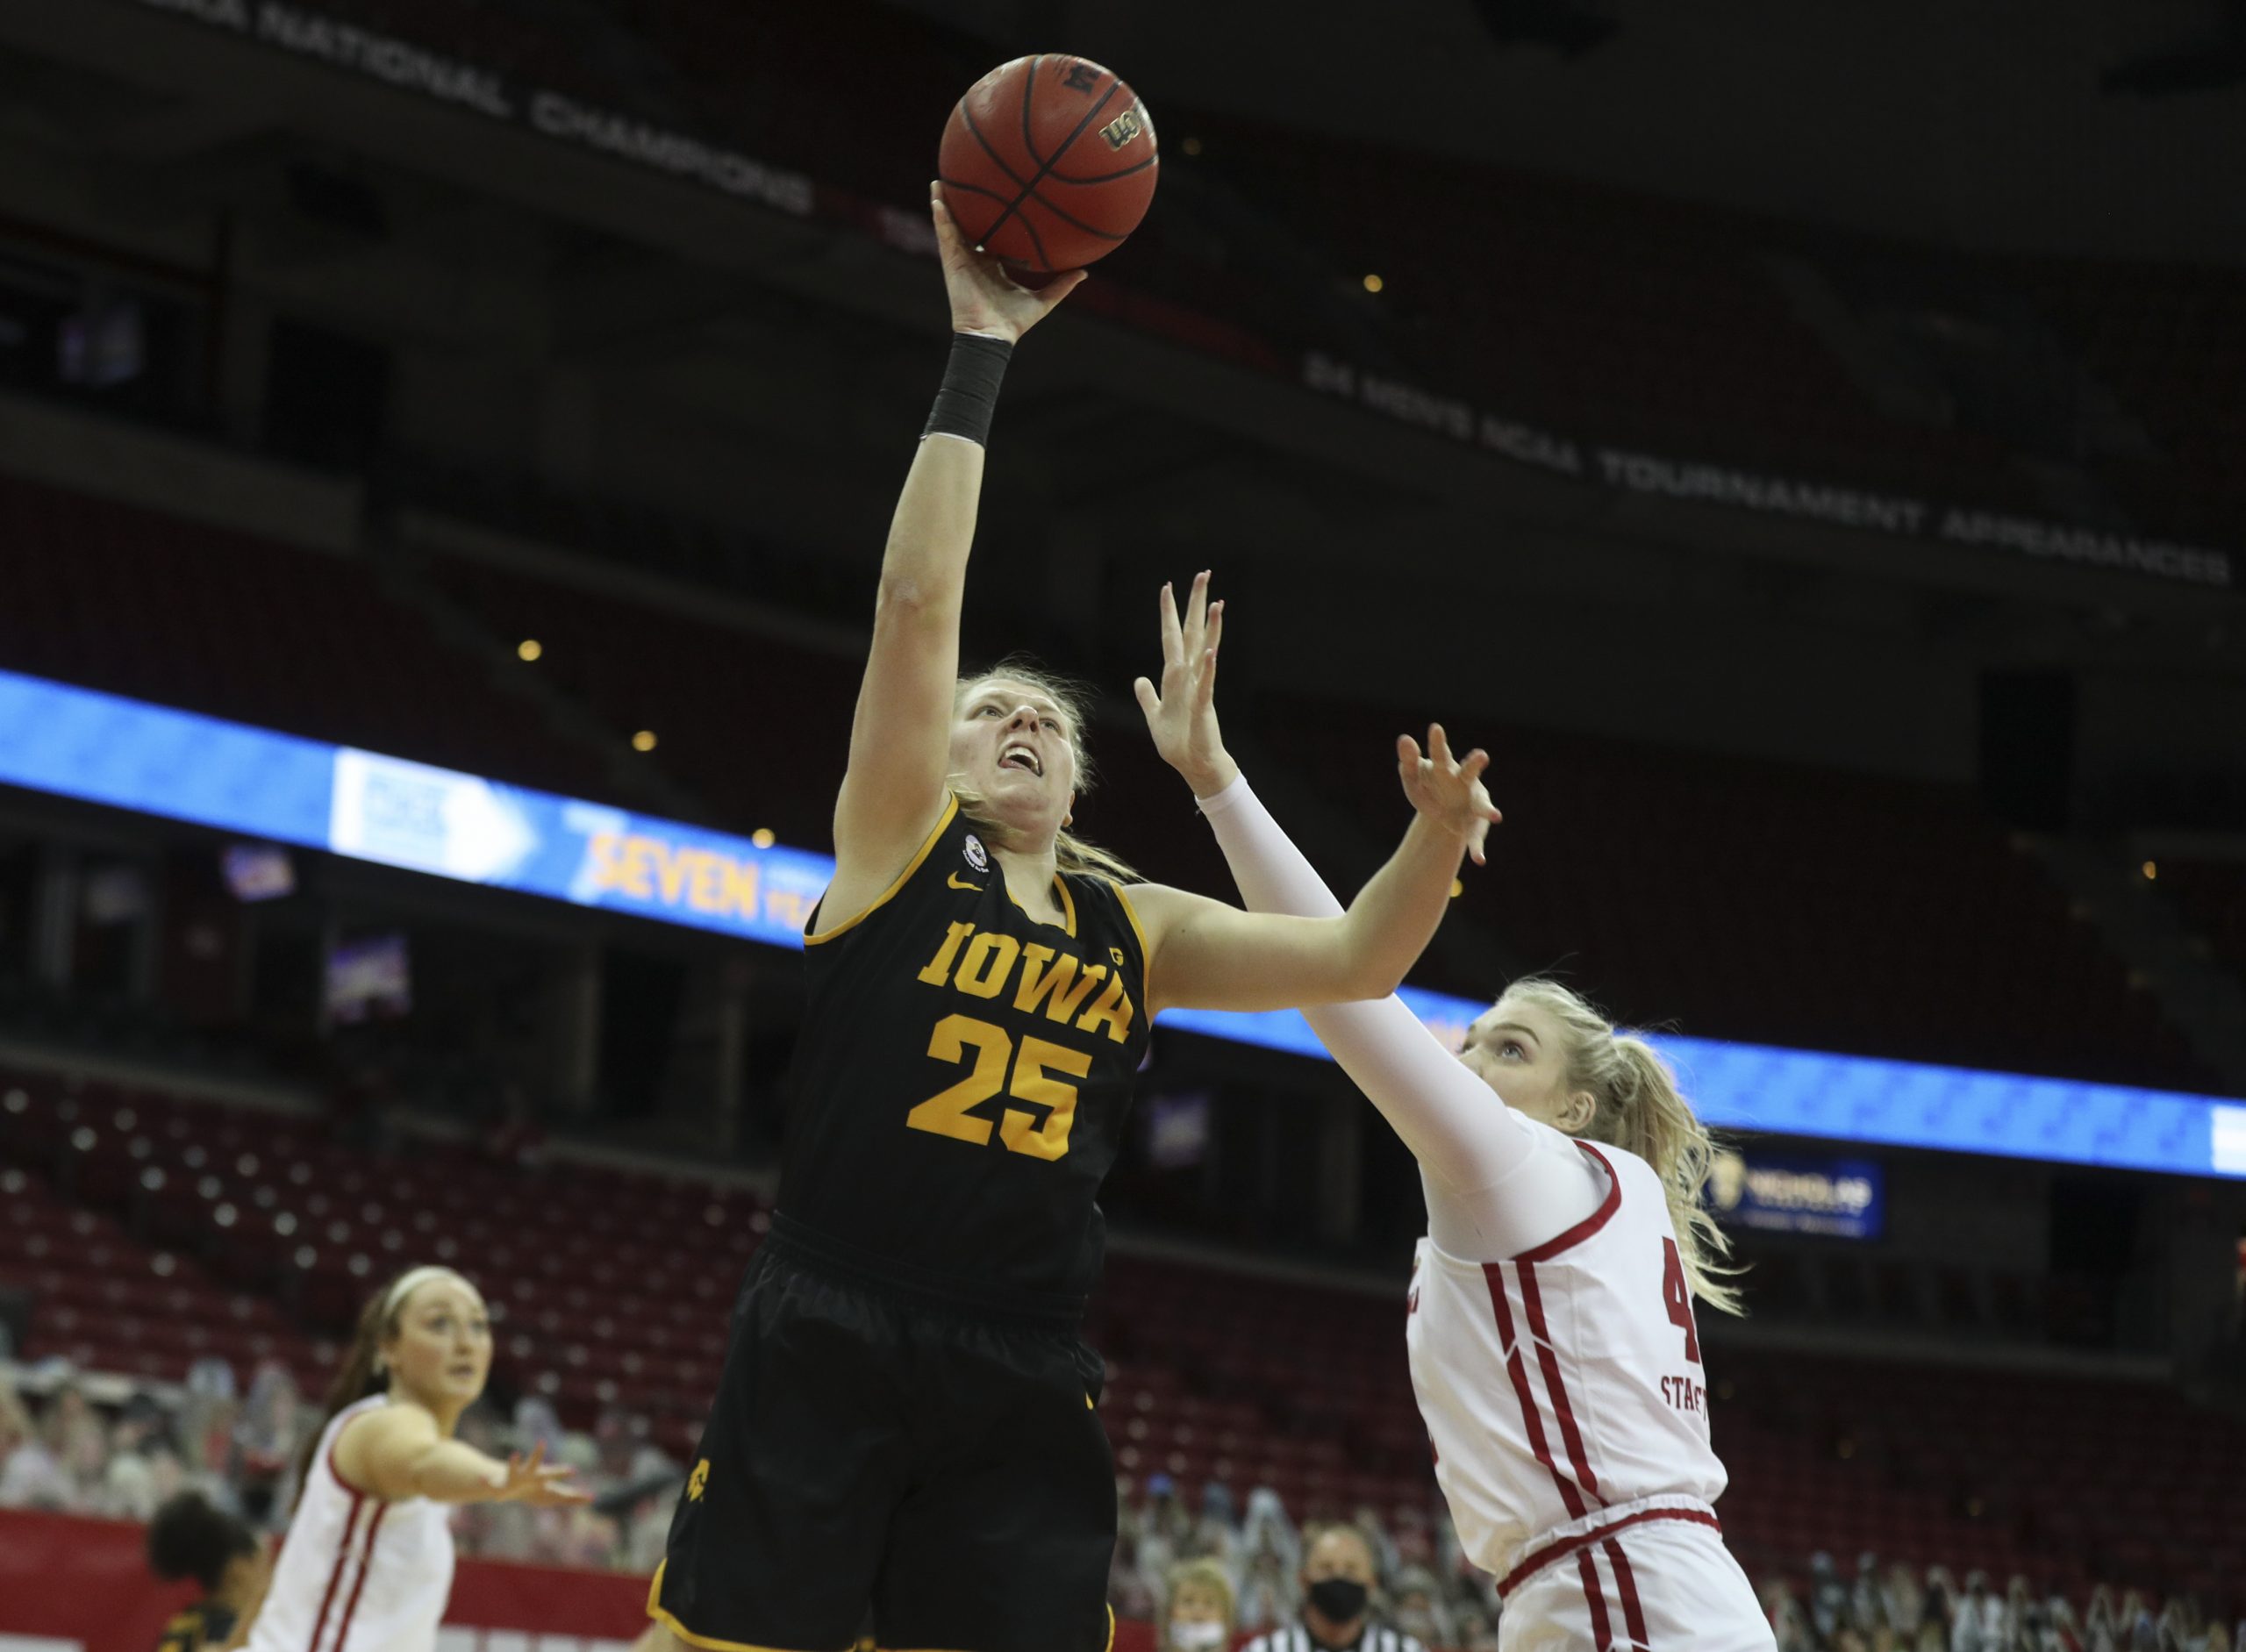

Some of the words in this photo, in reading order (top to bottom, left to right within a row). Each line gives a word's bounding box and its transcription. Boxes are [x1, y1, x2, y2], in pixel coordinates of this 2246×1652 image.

[256, 1, 514, 118] NATIONAL
[531, 91, 815, 216] CHAMPIONS
[1303, 350, 1354, 397] 24
[1360, 371, 1475, 440] MEN'S
[1479, 414, 1583, 476] NCAA
[1597, 449, 1925, 536] TOURNAMENT
[1940, 508, 2231, 586] APPEARANCES
[589, 833, 760, 920] SEVEN
[917, 919, 1134, 1044] IOWA
[906, 1012, 1093, 1162] 25
